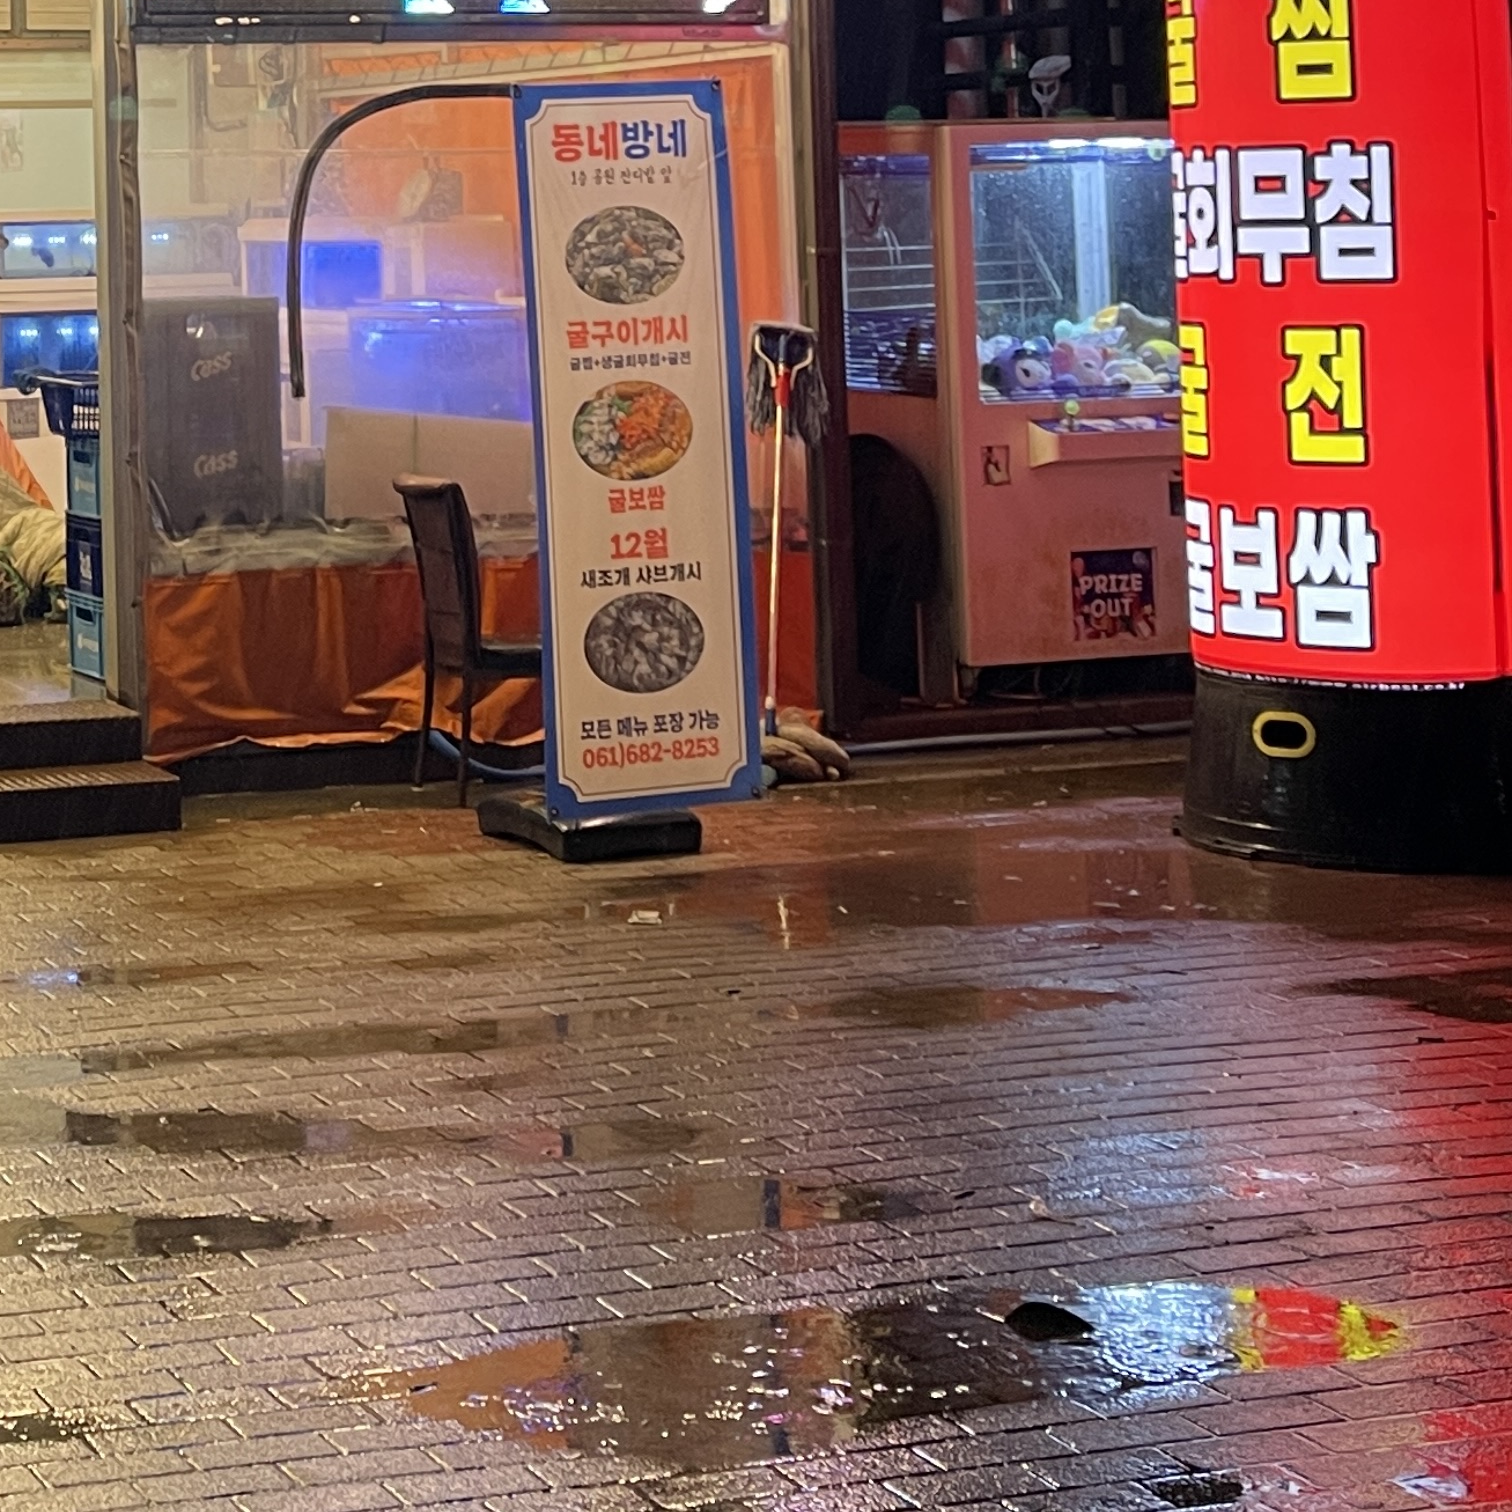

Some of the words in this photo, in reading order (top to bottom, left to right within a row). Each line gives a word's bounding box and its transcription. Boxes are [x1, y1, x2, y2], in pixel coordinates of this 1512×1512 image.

[551, 119, 687, 163] 동네방네
[566, 314, 689, 349] 굴구이개시
[1283, 326, 1366, 463] 전
[610, 527, 669, 560] 12월
[581, 567, 630, 589] 새조개
[636, 561, 702, 585] 샤브개시
[1079, 573, 1143, 595] PRIZE
[1091, 598, 1133, 618] OUT
[581, 719, 612, 740] 모든
[617, 716, 648, 737] 메뉴
[654, 712, 684, 733] 포장
[689, 709, 720, 730] 가능
[582, 737, 720, 769] 061)682-8253
